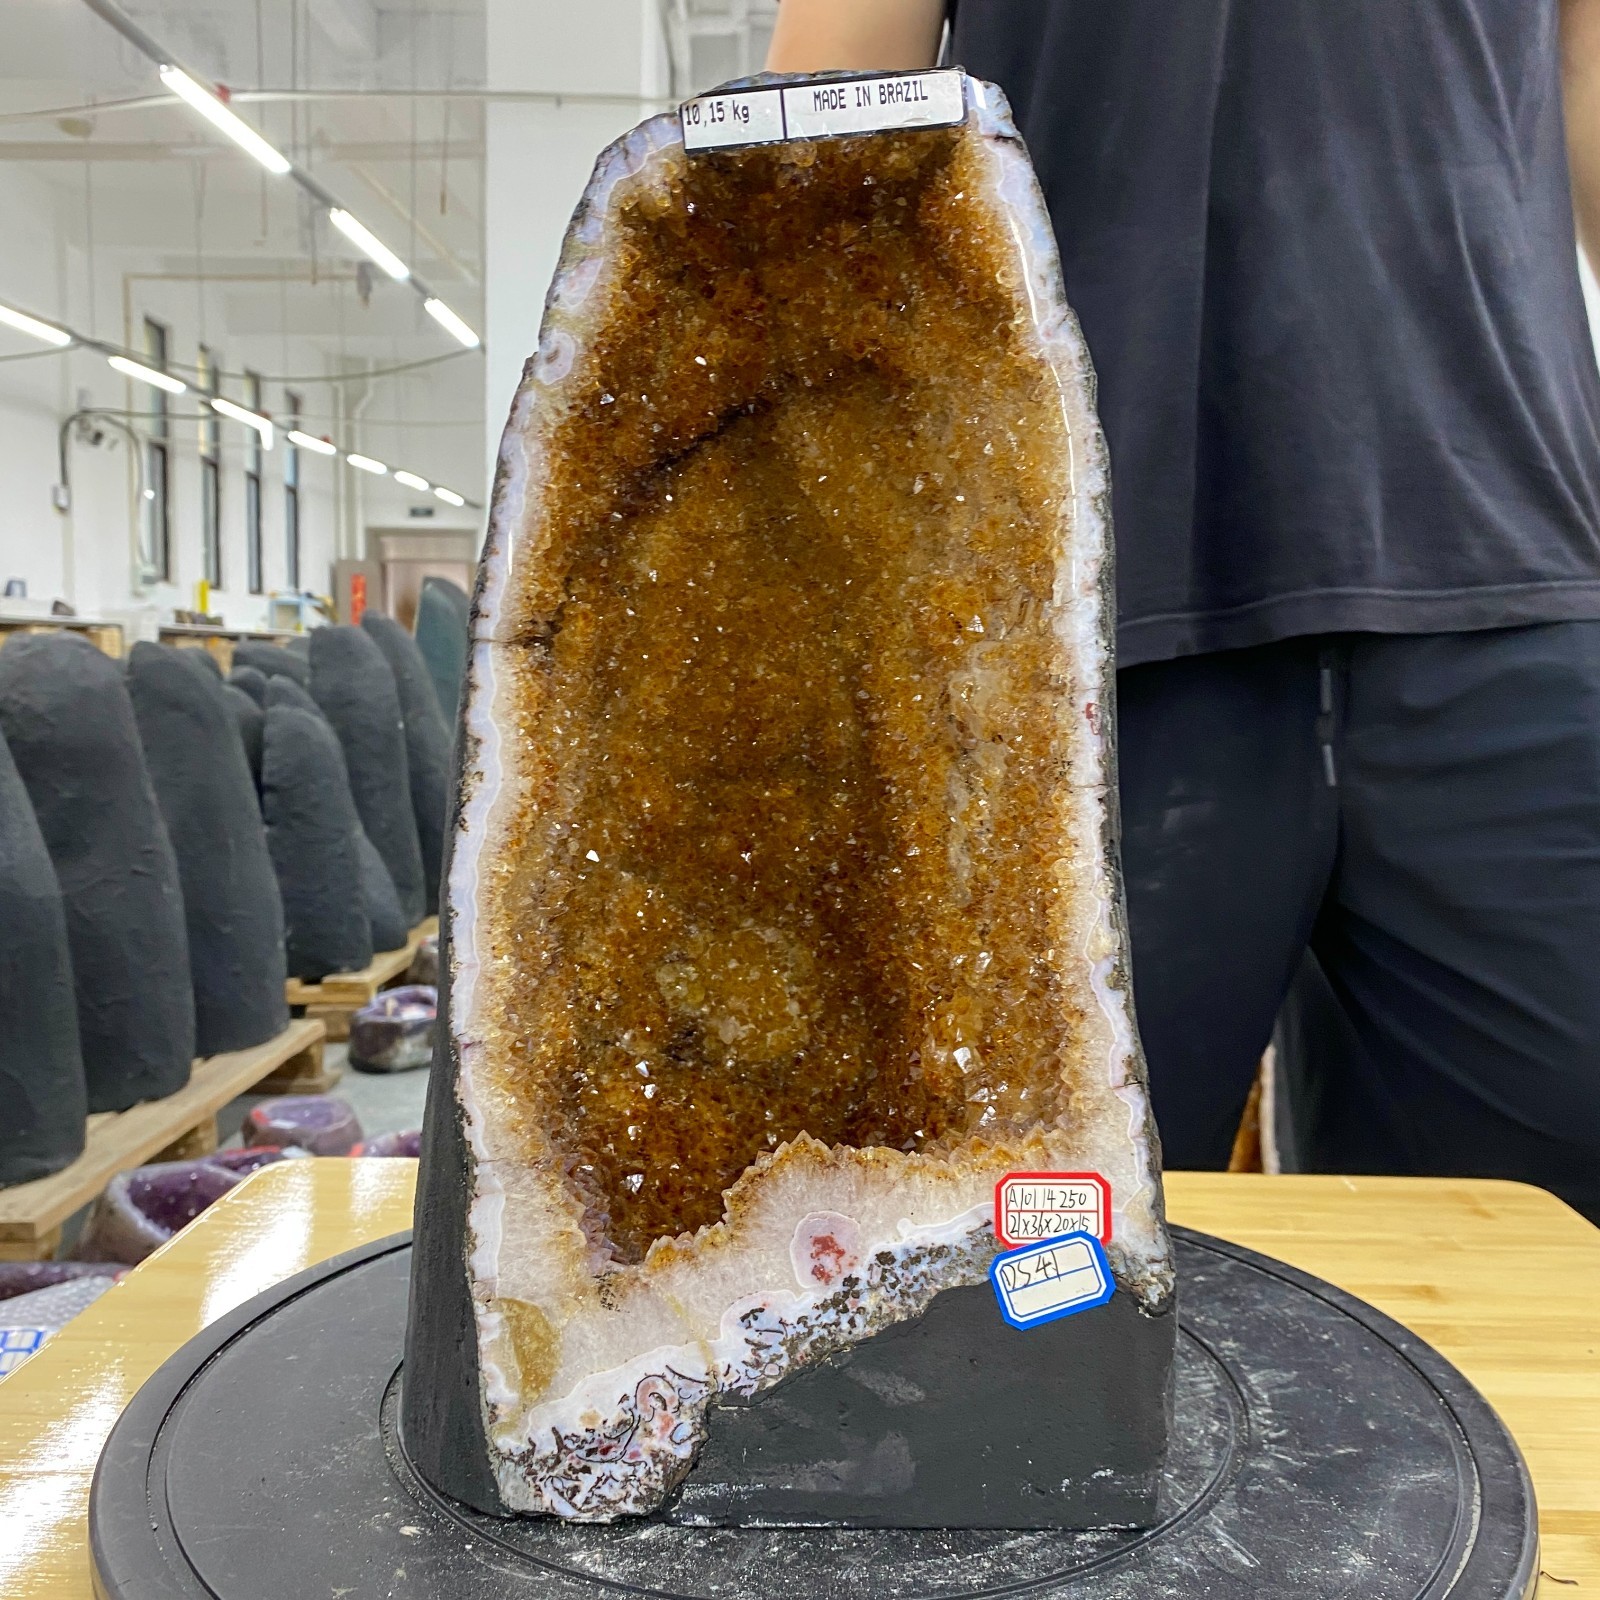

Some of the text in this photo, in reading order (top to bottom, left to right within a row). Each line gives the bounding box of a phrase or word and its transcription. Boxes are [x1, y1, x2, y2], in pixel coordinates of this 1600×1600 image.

[813, 80, 928, 112] MADE IN BRAZIL
[685, 100, 750, 127] 10,15 kg
